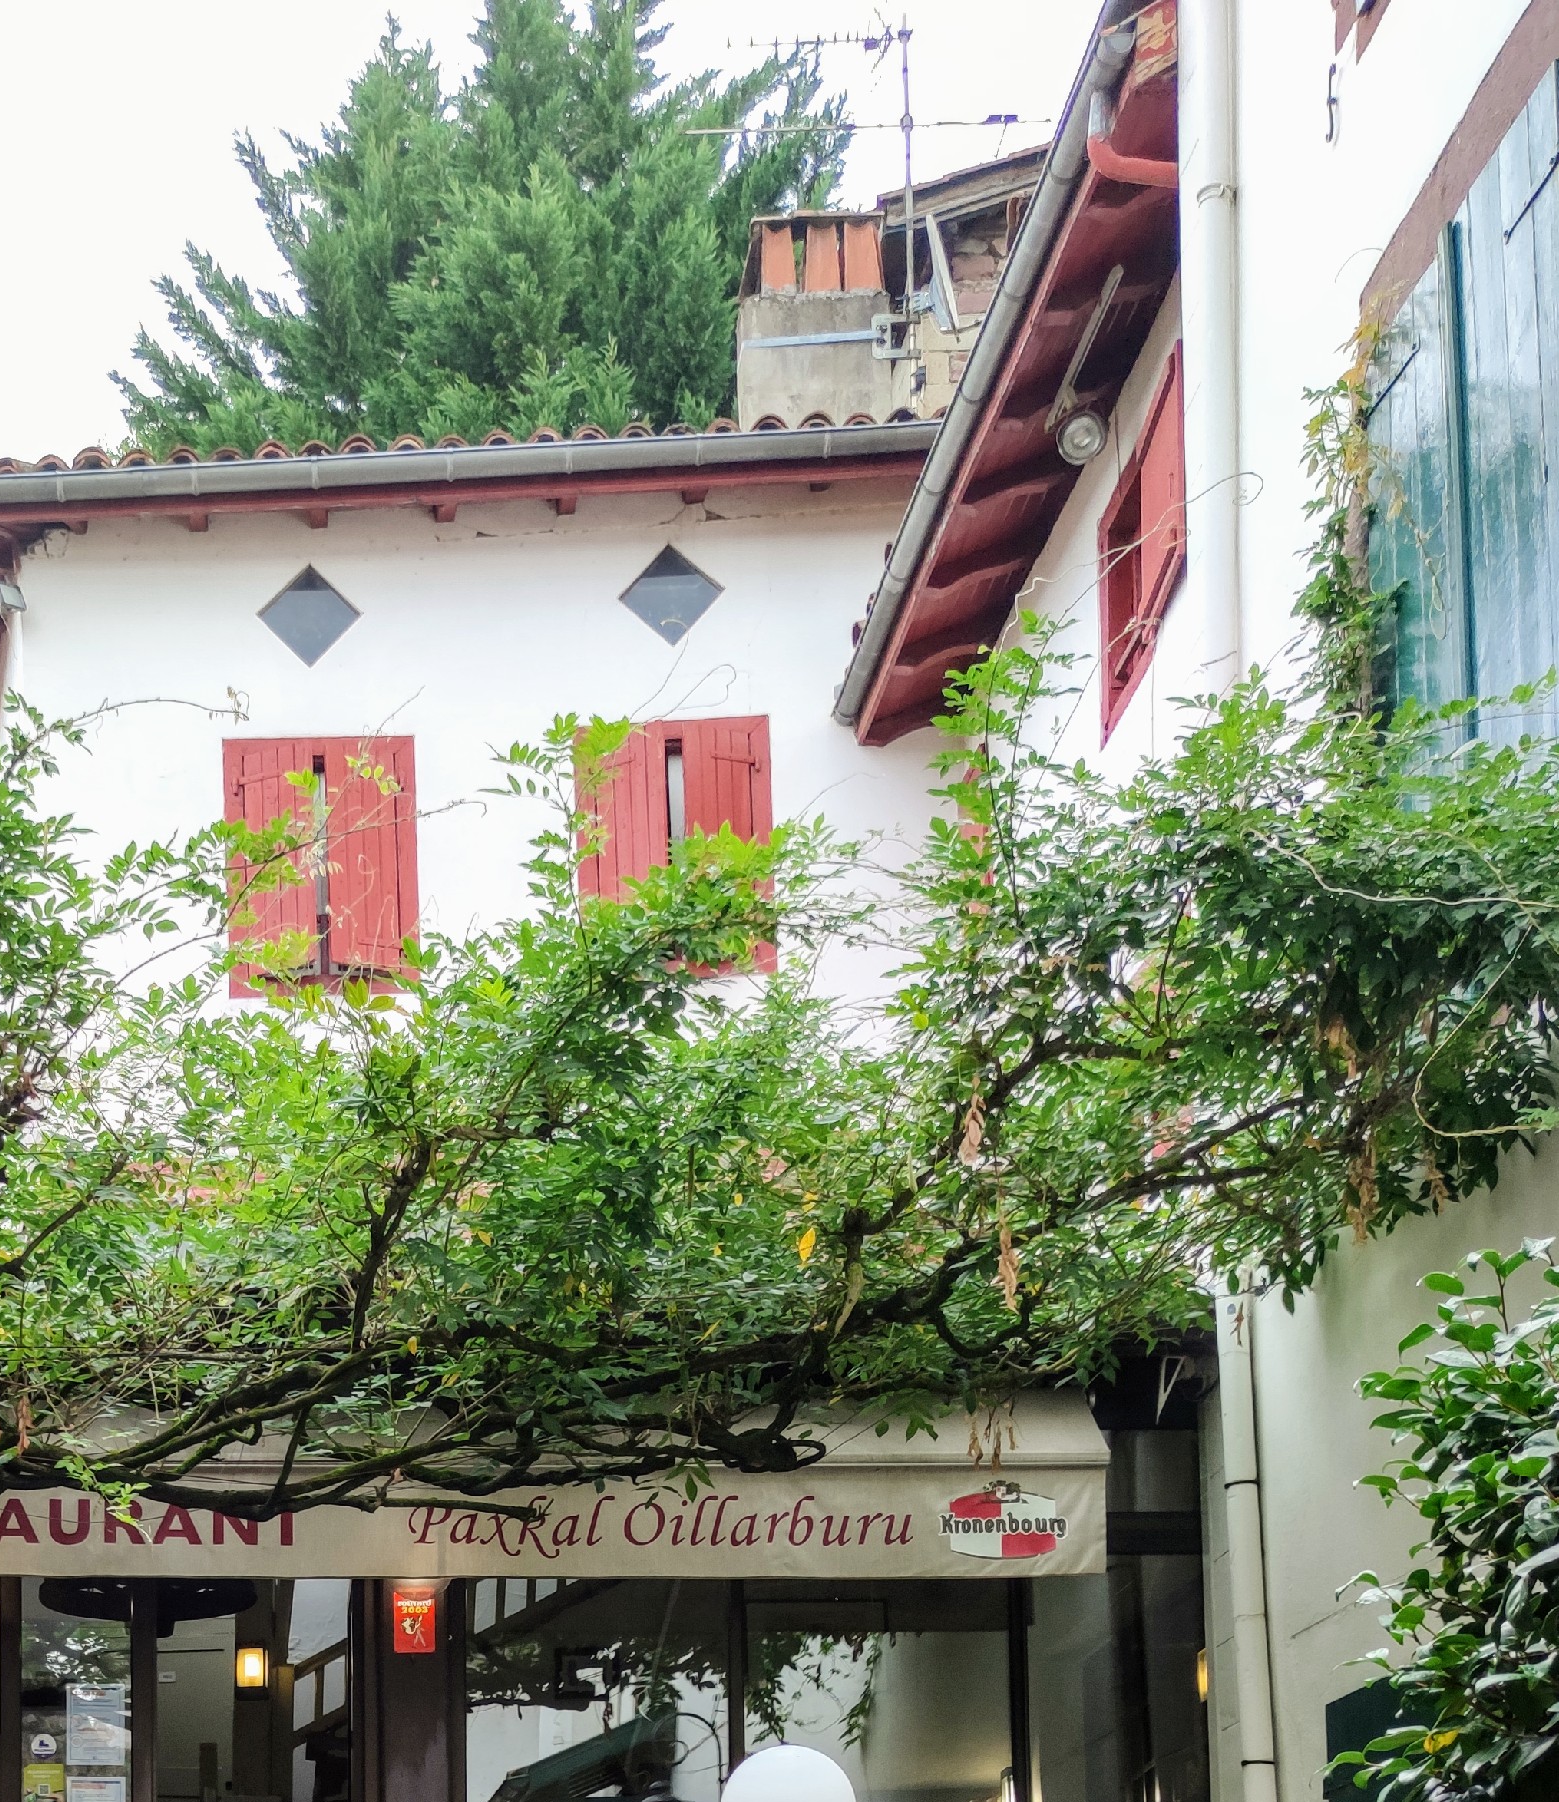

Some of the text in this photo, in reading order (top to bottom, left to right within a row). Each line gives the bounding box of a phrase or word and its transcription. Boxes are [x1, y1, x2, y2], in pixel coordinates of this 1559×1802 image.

[408, 1495, 914, 1559] Paxkal Oillarburu
[940, 1512, 1067, 1538] Kronenbourg
